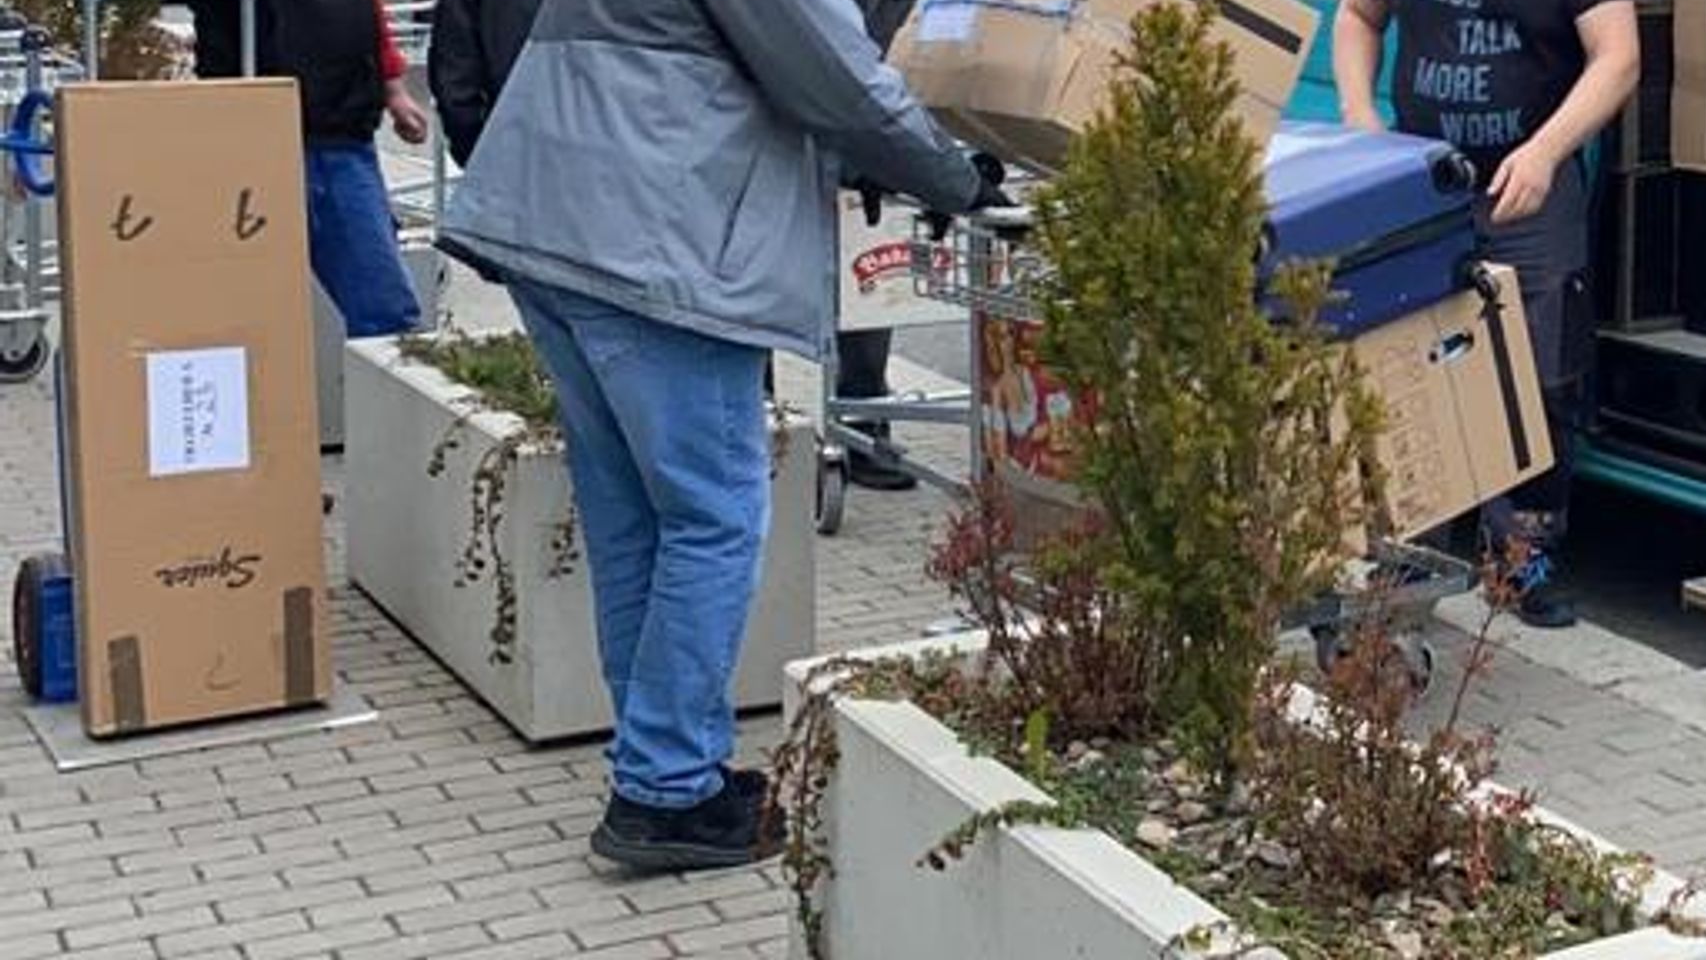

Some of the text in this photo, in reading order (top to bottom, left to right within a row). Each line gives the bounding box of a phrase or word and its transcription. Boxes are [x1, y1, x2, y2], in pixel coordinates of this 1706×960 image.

[1456, 16, 1522, 56] TALK
[1413, 56, 1491, 103] MORE
[1440, 107, 1525, 144] WORK
